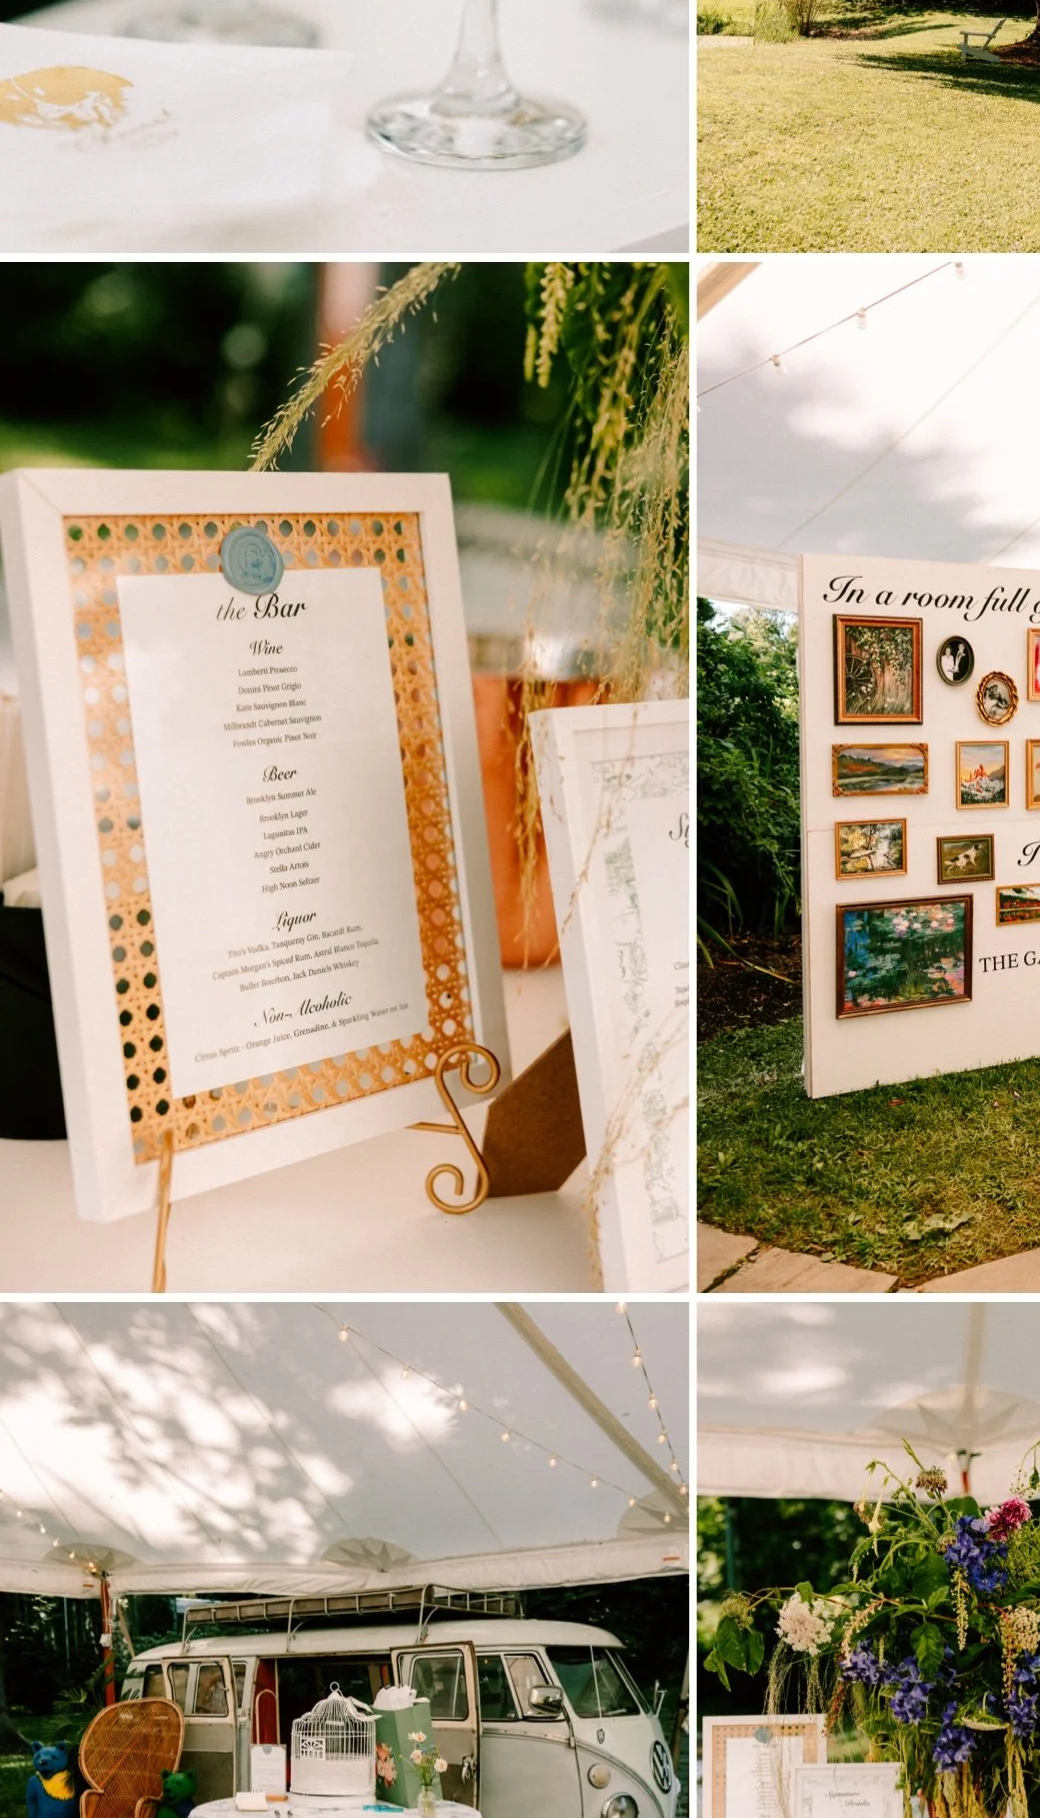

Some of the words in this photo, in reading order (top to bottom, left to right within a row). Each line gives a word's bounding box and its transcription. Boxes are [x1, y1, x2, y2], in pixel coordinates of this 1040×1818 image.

[216, 597, 247, 621] the
[254, 593, 308, 619] Bar
[823, 575, 870, 604] In
[875, 590, 898, 606] a
[901, 591, 979, 611] room
[964, 586, 1030, 622] full
[249, 640, 284, 655] Wine
[238, 667, 268, 677] Lamberti
[270, 665, 298, 676] Prosecco
[263, 683, 280, 693] Pinot
[281, 681, 302, 693] Grigio
[253, 700, 288, 712] Sauvignon
[289, 698, 307, 708] Blanc
[258, 717, 288, 729] Cabernet
[289, 714, 322, 727] Sauvignon
[257, 736, 283, 748] Organic
[284, 733, 301, 743] Pinot
[302, 731, 317, 741] Noir
[262, 765, 297, 783] Beer
[246, 793, 276, 806] Brooklyn
[277, 790, 304, 800] Summer
[306, 787, 317, 797] Ale
[259, 812, 289, 824] Brooklyn
[290, 809, 308, 820] Lager
[263, 829, 295, 841] Lagunitas
[296, 826, 308, 835] IPA
[254, 849, 274, 861] Angry
[275, 844, 302, 856] Orchard
[303, 841, 321, 851] Cider
[269, 864, 288, 874] Stella
[289, 861, 309, 871] Artois
[262, 883, 278, 895] High
[280, 880, 298, 890] Noon
[298, 876, 320, 887] Seltzer
[272, 910, 317, 932] Liquor
[271, 936, 306, 951] Tanqueray
[306, 933, 321, 943] Gin,
[322, 927, 346, 940] Bacardi
[240, 960, 272, 976] Morgan's
[271, 954, 294, 968] Spiced
[294, 950, 313, 962] Rum,
[313, 945, 333, 958] Astral
[334, 942, 356, 955] Blanco
[979, 954, 1019, 973] THE
[261, 974, 292, 988] Bourbon,
[292, 969, 307, 981] Jack
[308, 964, 333, 978] Daniels
[333, 958, 360, 973] Whiskey
[253, 990, 352, 1027] Non-Alcoholic
[246, 1038, 272, 1052] Orange
[293, 1022, 331, 1037] Grenadine,
[331, 1020, 337, 1028] &
[338, 1012, 370, 1028] Sparkling
